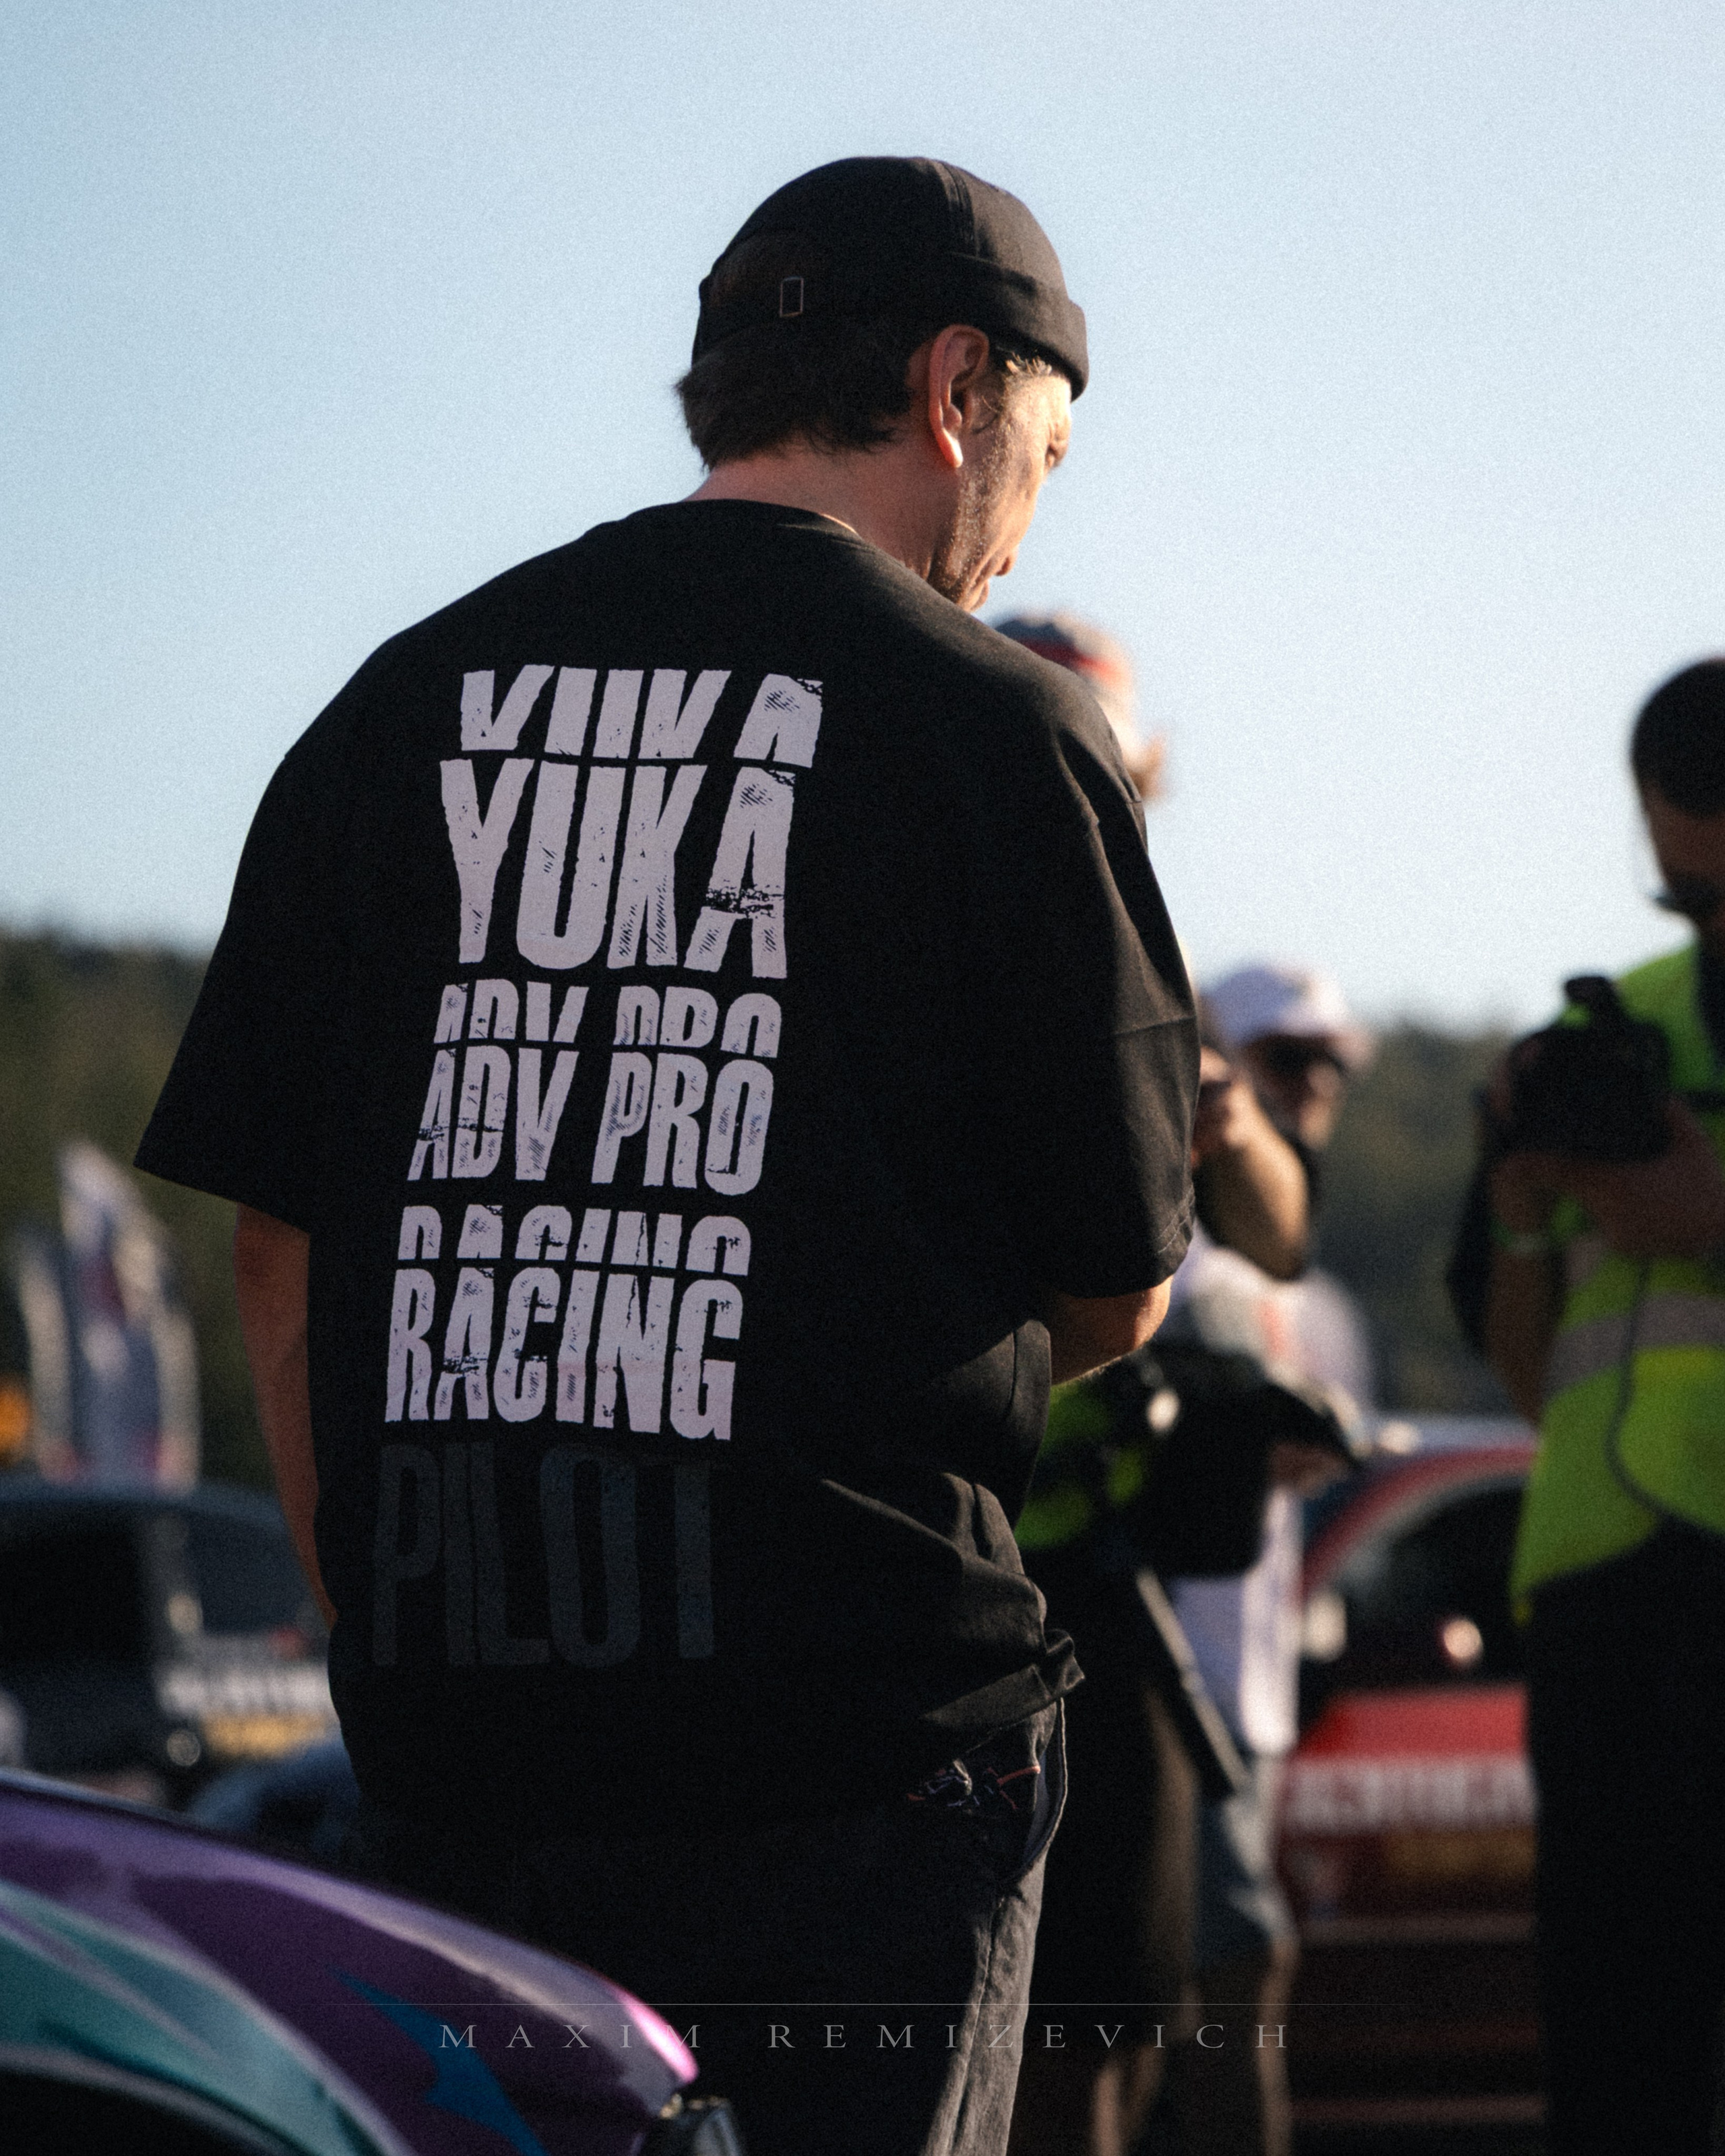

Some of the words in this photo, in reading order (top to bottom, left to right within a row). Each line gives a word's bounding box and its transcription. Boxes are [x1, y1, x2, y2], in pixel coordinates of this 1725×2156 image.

[440, 759, 794, 978] YUKA
[408, 1046, 579, 1180] ADV
[592, 1052, 774, 1195] PRO
[385, 1267, 743, 1440] RACING
[373, 1441, 731, 1668] PILOT
